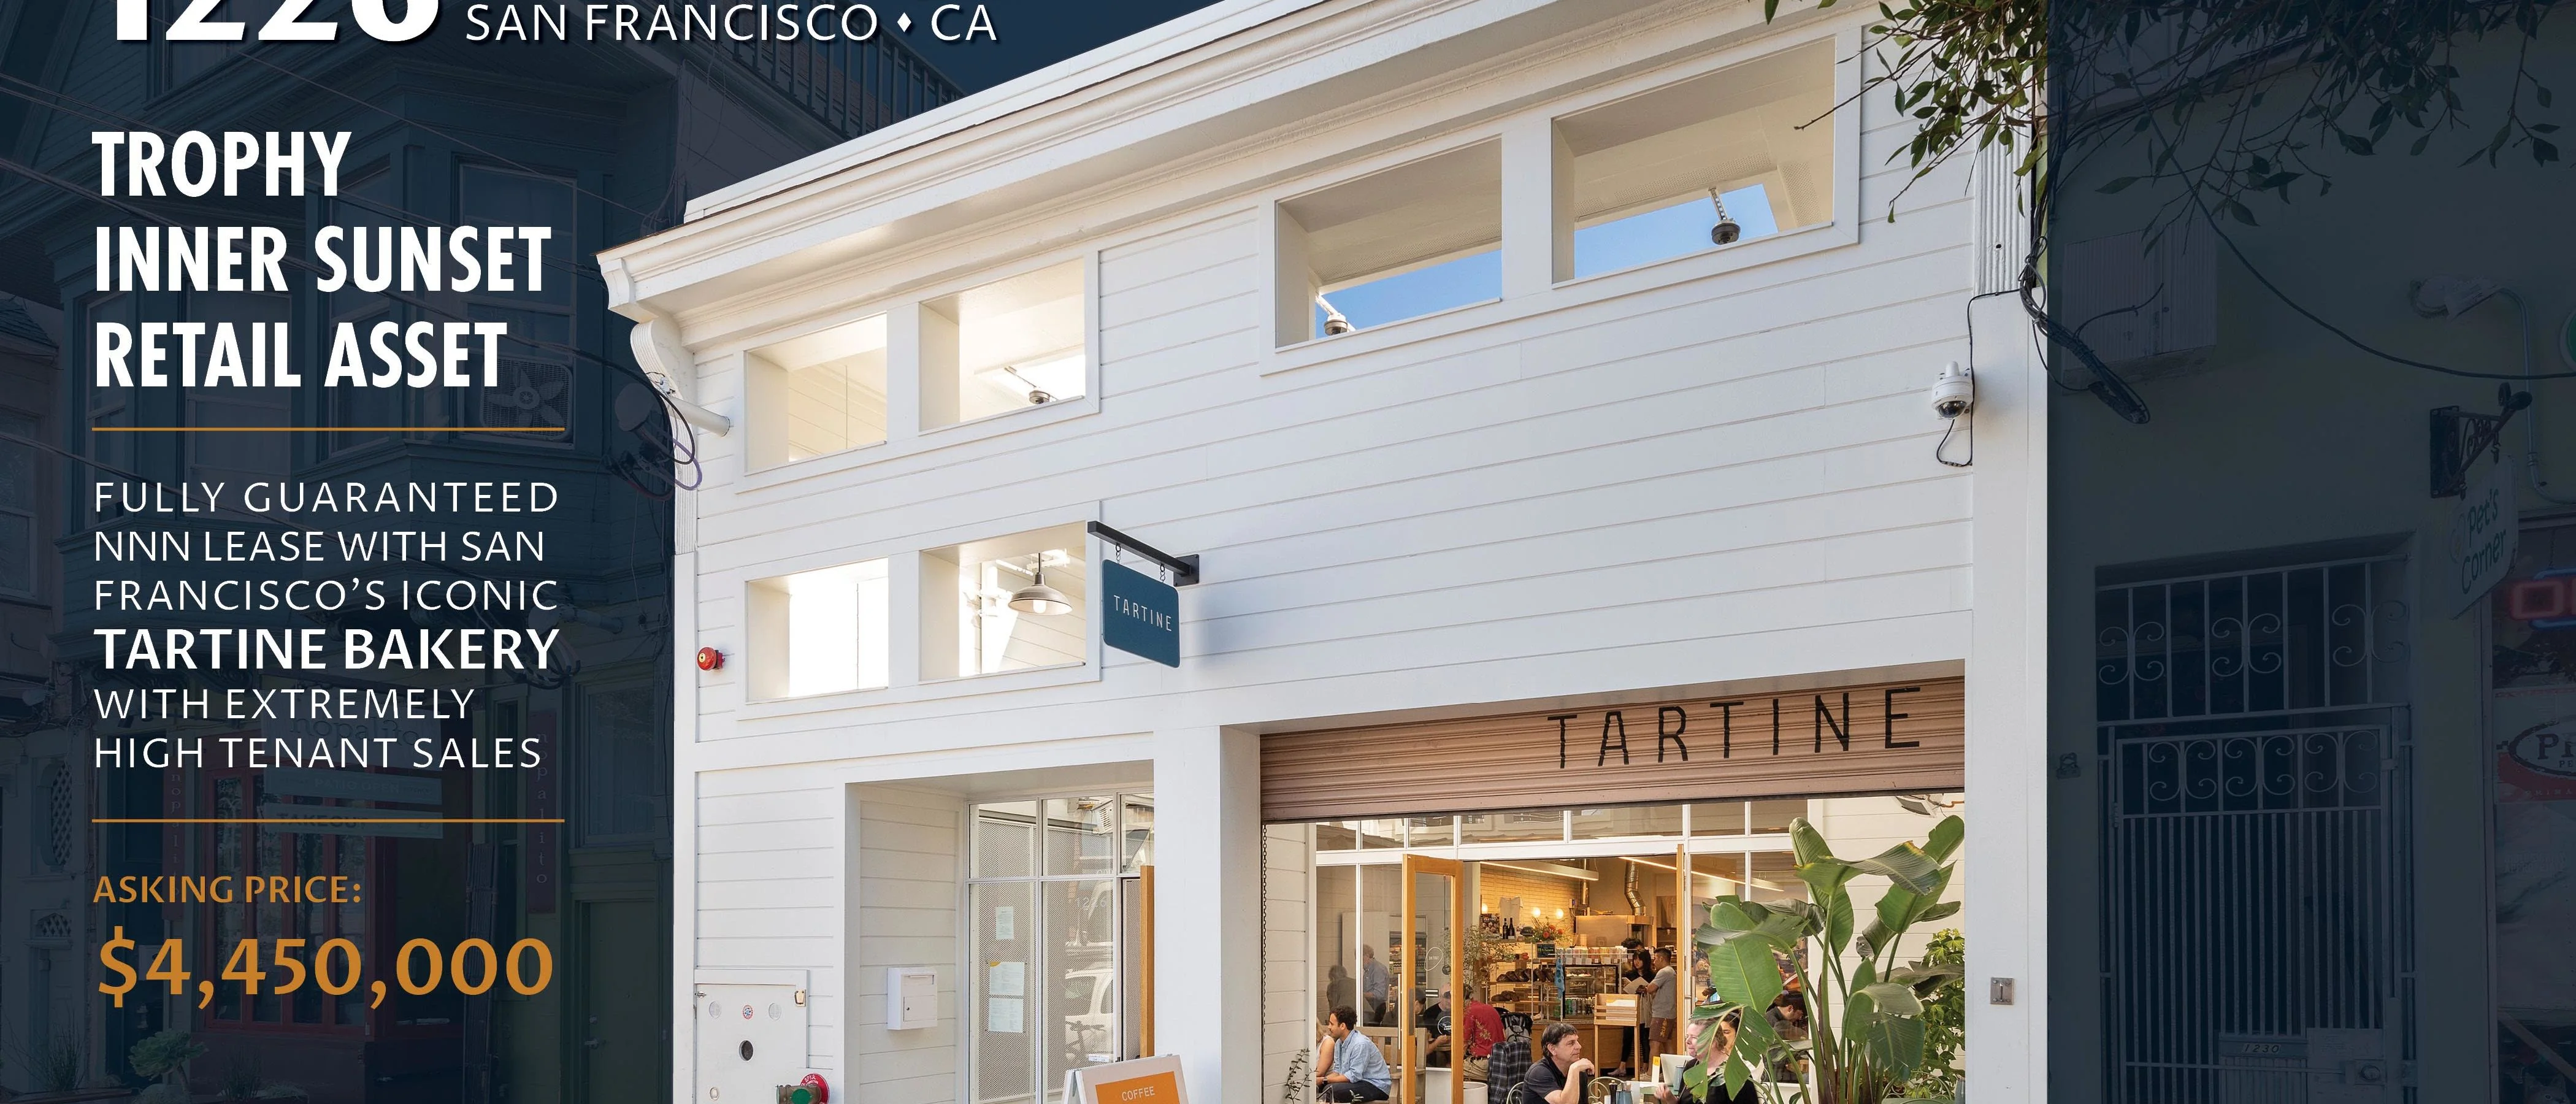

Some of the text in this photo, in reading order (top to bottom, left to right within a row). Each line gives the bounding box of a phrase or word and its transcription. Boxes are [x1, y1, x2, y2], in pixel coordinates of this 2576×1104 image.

[1114, 595, 1172, 632] TARTINE
[1547, 686, 1920, 770] TARTINE
[2244, 1044, 2280, 1053] 1230
[1122, 1086, 1156, 1101] COFFEE
